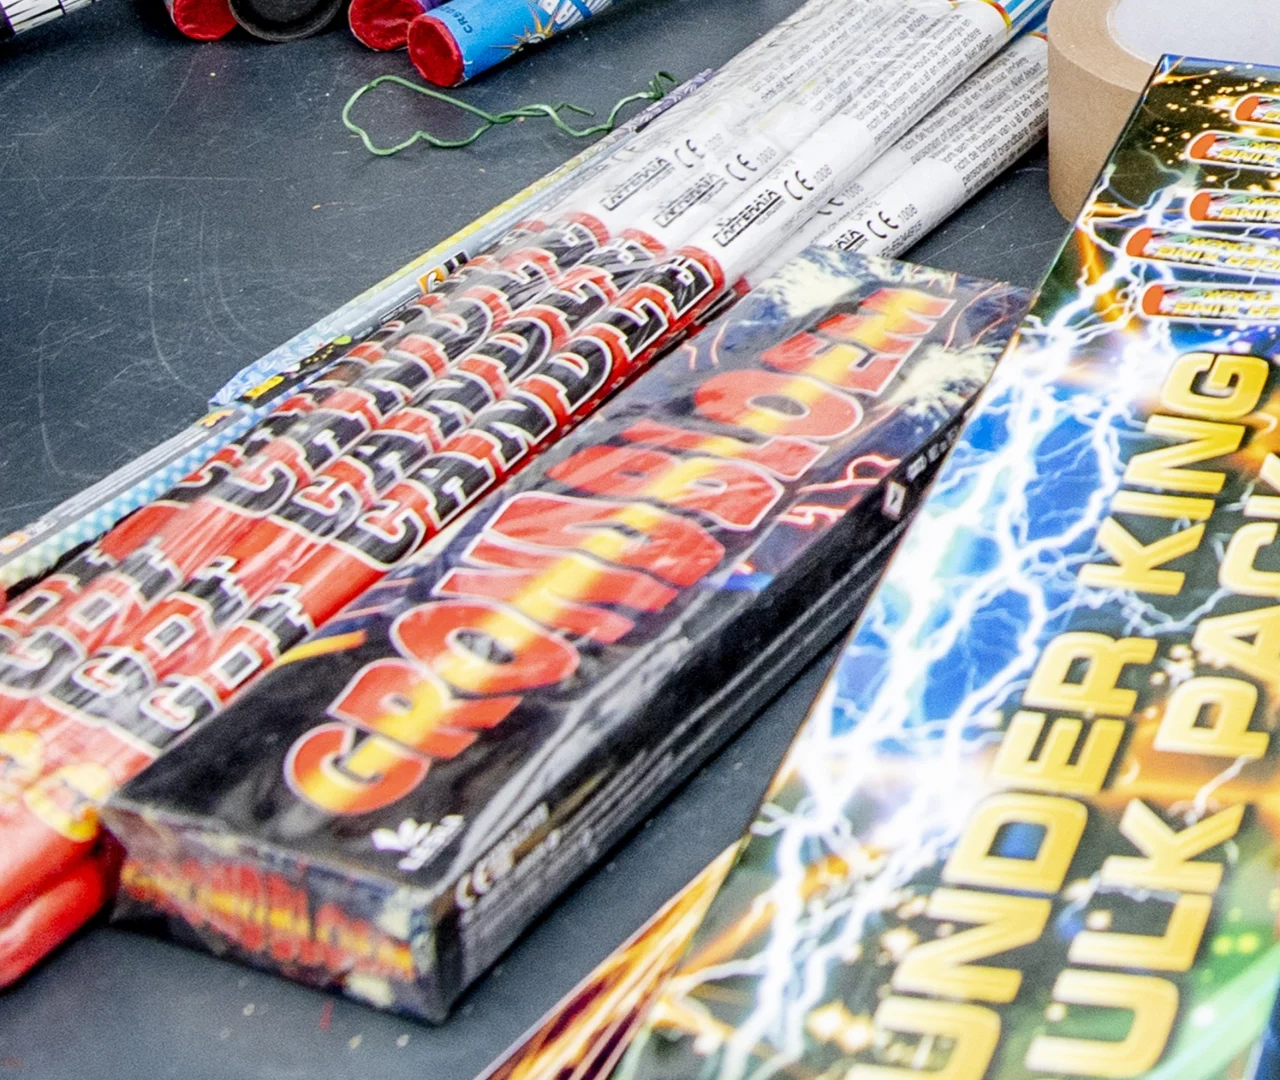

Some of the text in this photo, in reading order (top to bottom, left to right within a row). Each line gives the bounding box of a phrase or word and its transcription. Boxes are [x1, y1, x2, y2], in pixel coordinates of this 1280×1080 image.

[845, 350, 1272, 1080] UNDER KING
[1018, 792, 1255, 1080] ULK
